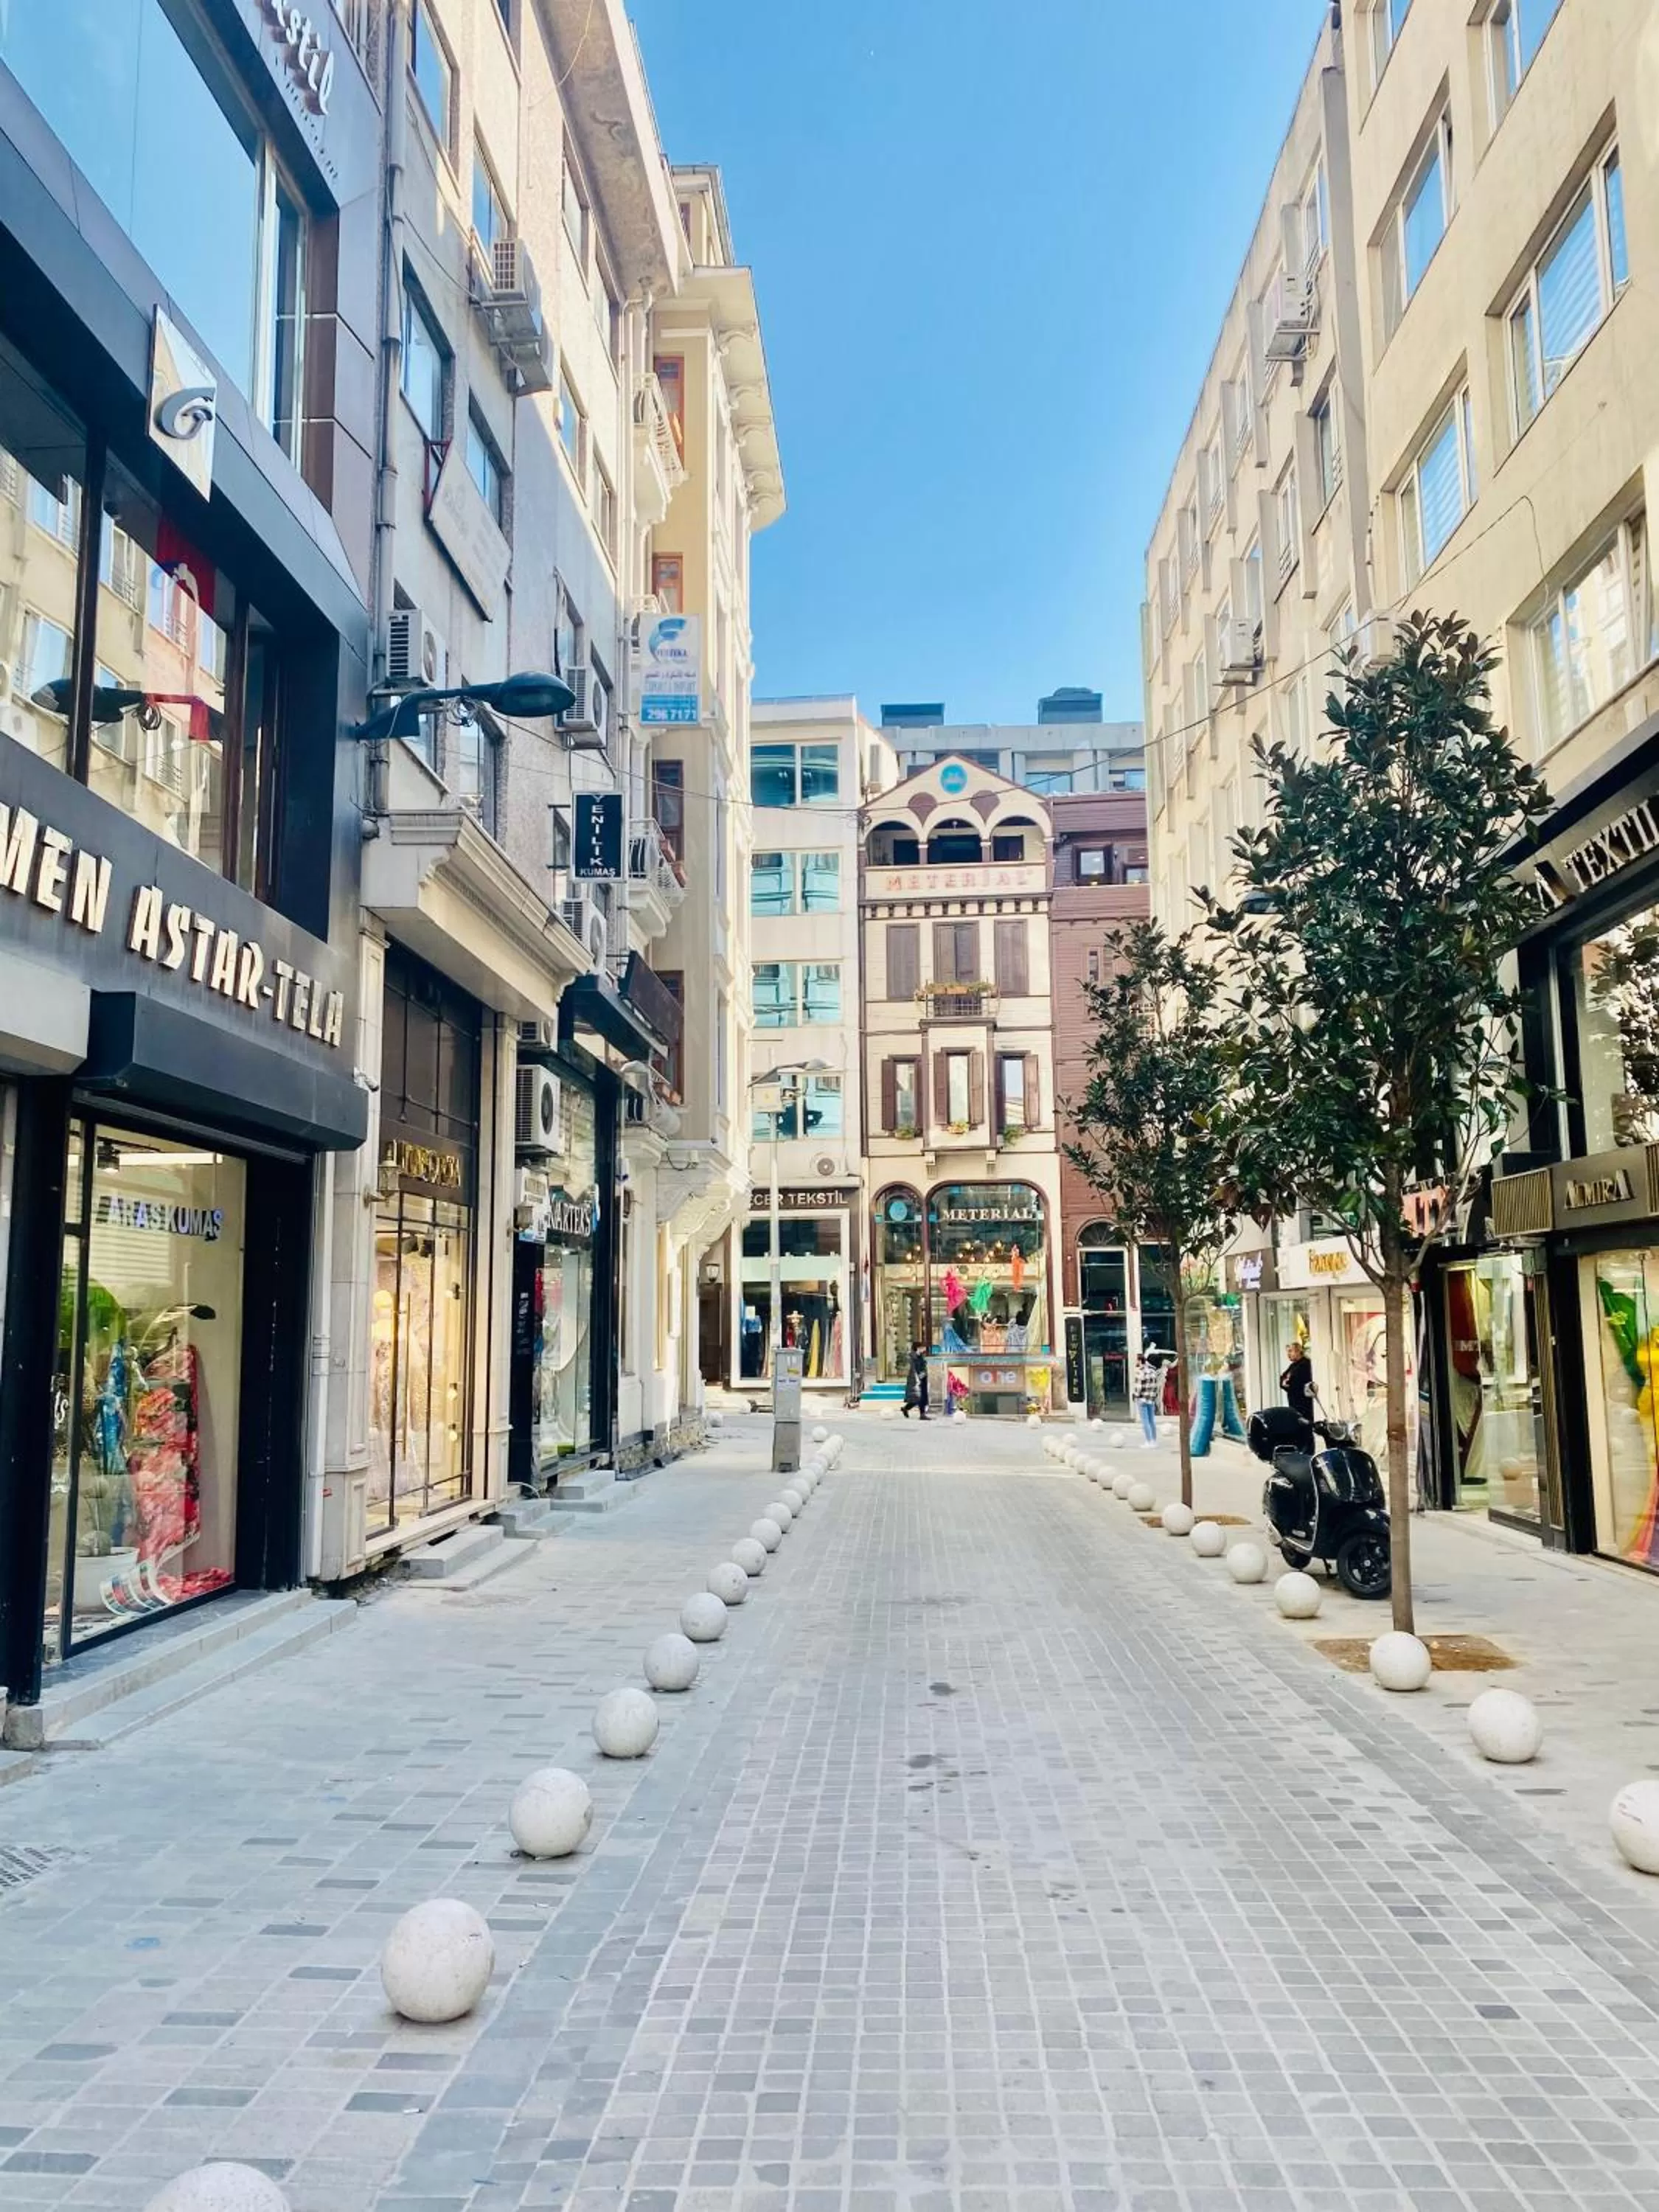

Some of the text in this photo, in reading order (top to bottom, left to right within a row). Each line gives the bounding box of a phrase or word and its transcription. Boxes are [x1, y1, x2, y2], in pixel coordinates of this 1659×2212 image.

[129, 885, 344, 1048] ASTAR-TELA
[787, 1189, 848, 1205] TEKSTİL
[943, 1205, 1032, 1220] METERİAL
